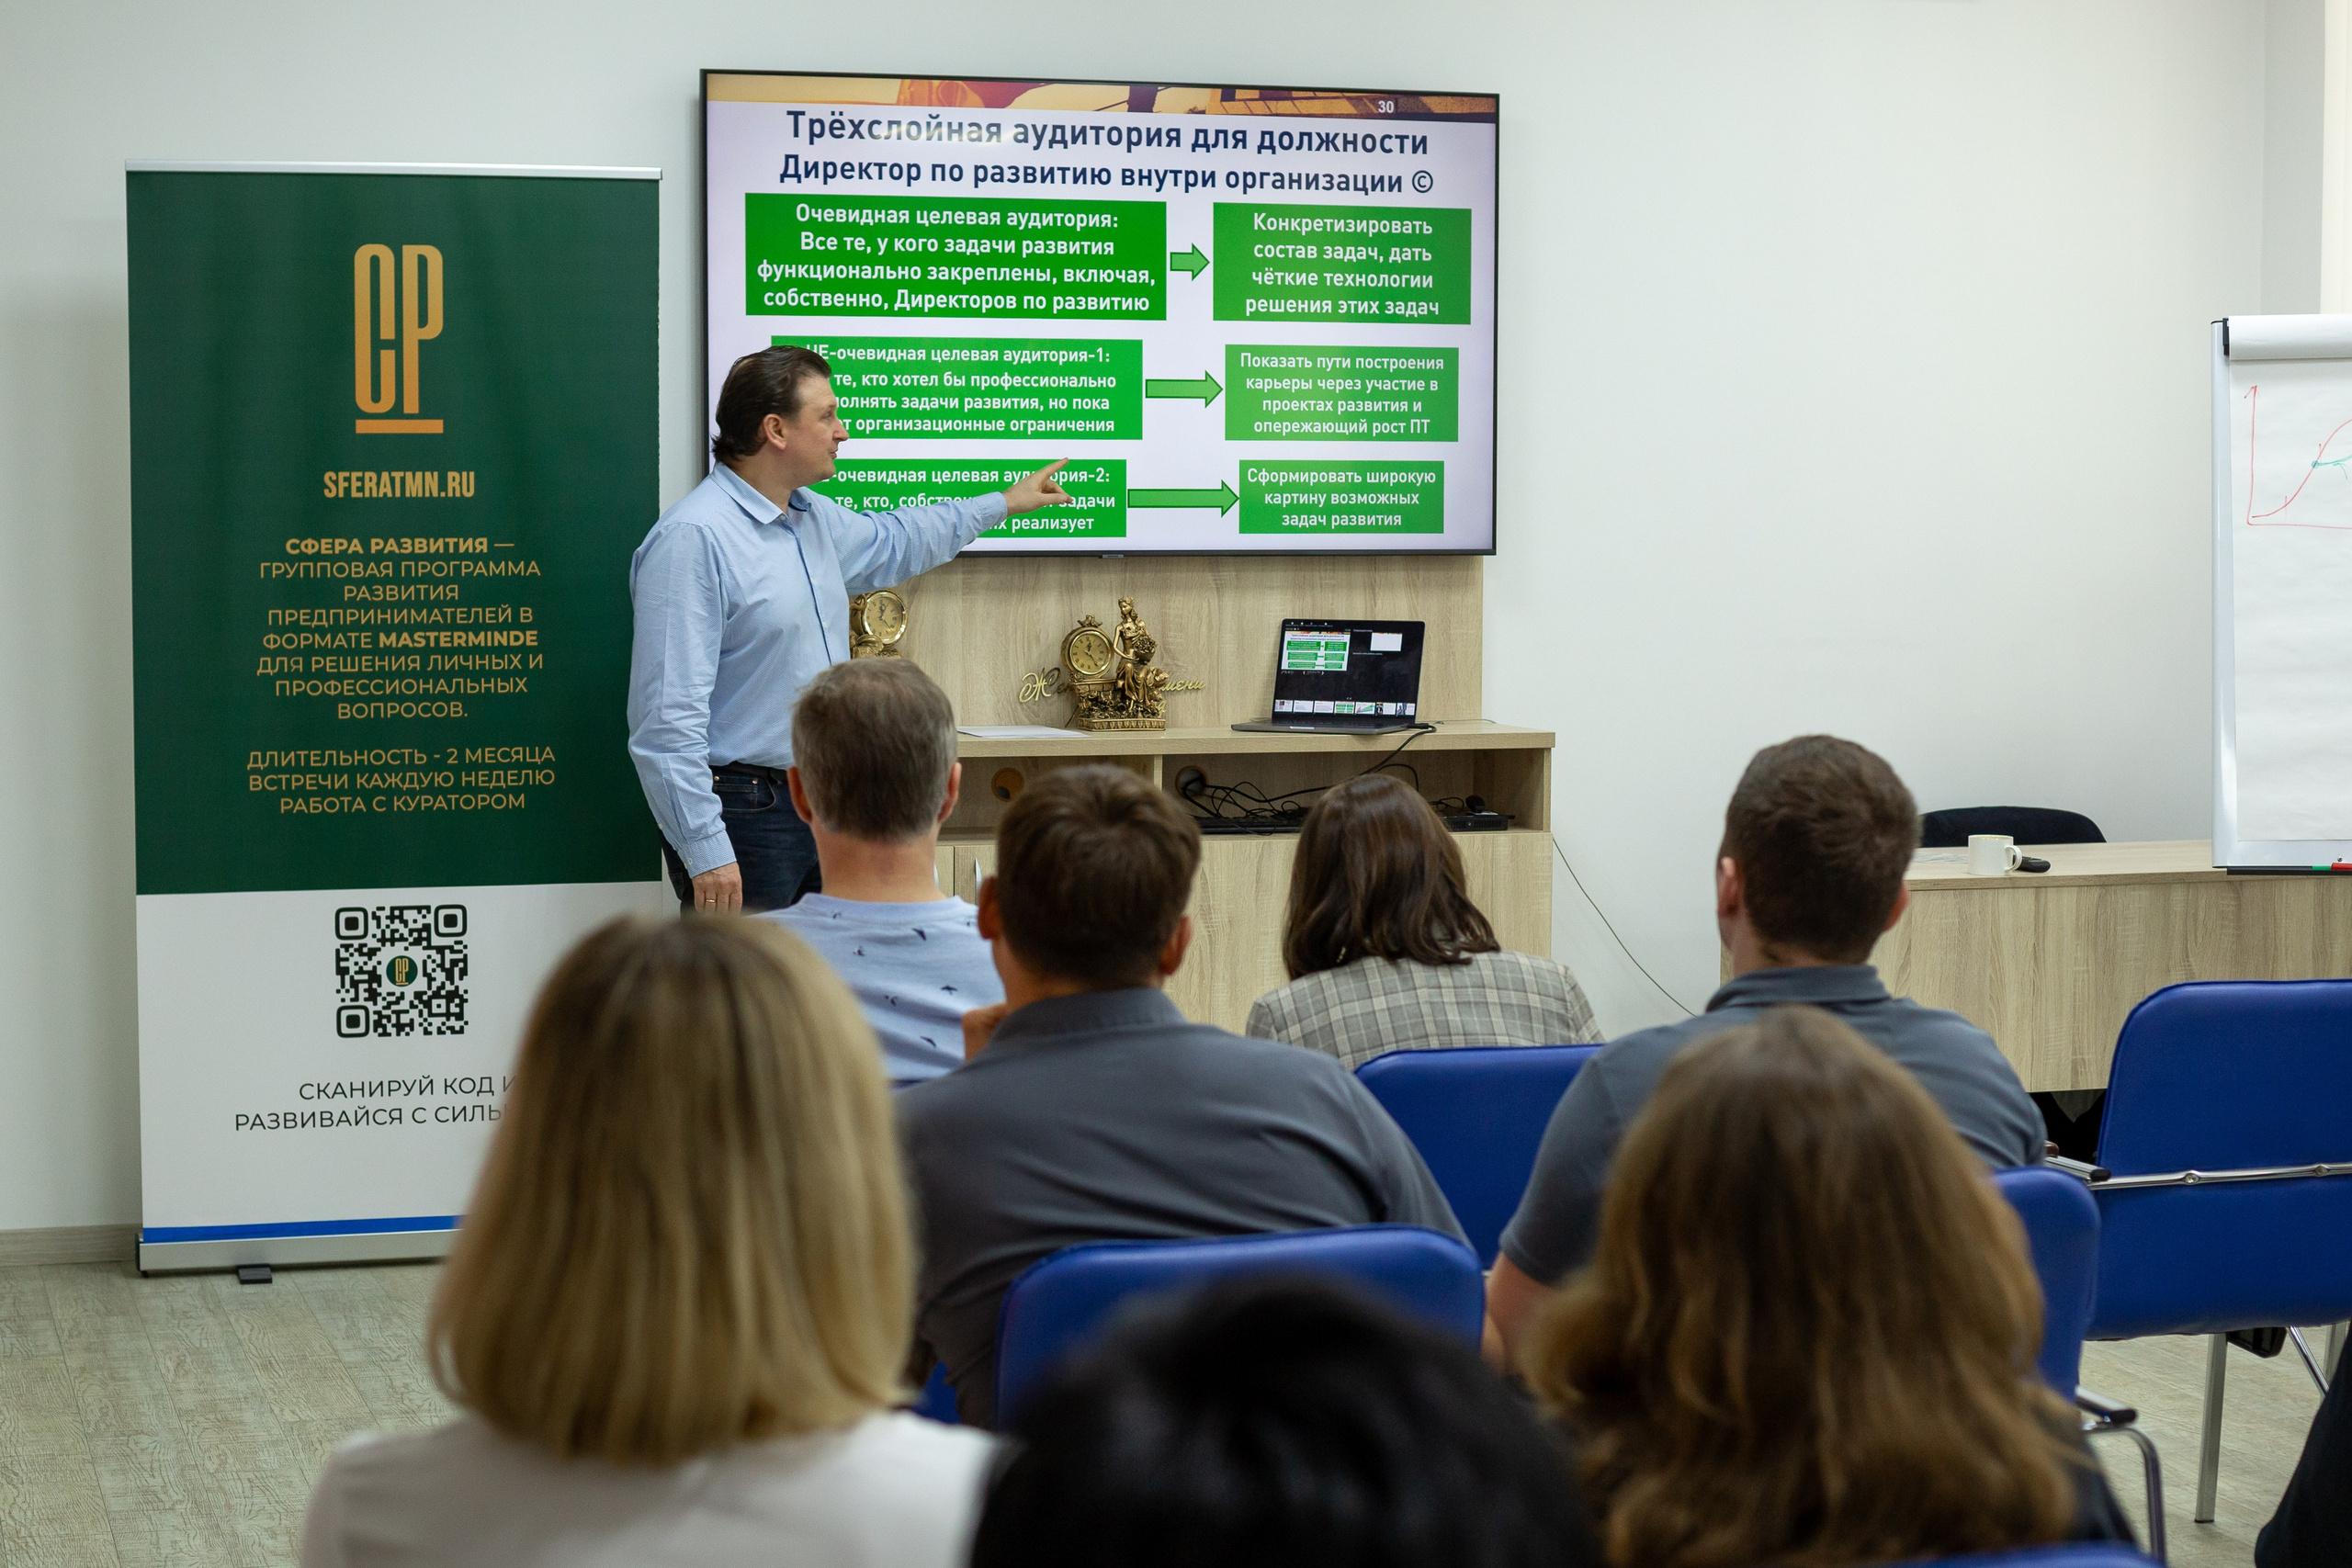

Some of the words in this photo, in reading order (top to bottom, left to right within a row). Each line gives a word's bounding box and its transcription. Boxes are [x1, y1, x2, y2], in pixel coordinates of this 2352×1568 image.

[1377, 100, 1395, 114] 30
[786, 109, 1001, 146] Трёхслойная
[1013, 123, 1182, 153] аудитория
[1191, 128, 1248, 153] для
[1257, 130, 1428, 155] должности
[779, 153, 922, 187] Директор
[931, 164, 964, 183] по
[974, 164, 1112, 189] развитию
[1123, 168, 1216, 194] внутри
[1225, 170, 1402, 197] организации
[796, 203, 910, 226] Очевидная
[916, 209, 1001, 227] целевая
[1006, 211, 1118, 231] аудитория:
[1253, 212, 1433, 238] Конкретизировать
[800, 231, 838, 251] Все
[842, 236, 872, 254] те,
[876, 237, 888, 256] у
[894, 237, 939, 253] кого
[944, 238, 1016, 256] задачи
[1022, 240, 1114, 258] развития
[1253, 243, 1317, 259] состав
[1322, 245, 1384, 264] задач,
[1388, 247, 1432, 264] дать
[757, 259, 922, 283] функционально
[927, 265, 1057, 286] закреплены,
[1063, 268, 1155, 287] включая,
[1251, 266, 1318, 286] чёткие
[1323, 272, 1433, 288] технологии
[763, 288, 888, 310] собственно,
[894, 288, 1017, 313] Директоров
[1023, 295, 1046, 310] по
[1053, 296, 1149, 314] развитию
[1246, 299, 1332, 317] решения
[1338, 299, 1380, 314] этих
[1385, 300, 1439, 318] задач
[354, 243, 444, 414] СР
[931, 349, 999, 363] целевая
[1002, 346, 1110, 366] аудитория-1:
[1240, 352, 1313, 368] Показать
[1317, 357, 1351, 372] пути
[1355, 357, 1444, 373] построения
[833, 374, 857, 389] те,
[862, 374, 888, 386] кто
[892, 374, 939, 387] хотел
[943, 371, 966, 387] бы
[970, 371, 1116, 391] профессионально
[1246, 378, 1313, 393] карьеры
[1317, 378, 1362, 394] через
[1365, 378, 1426, 394] участие
[1430, 379, 1439, 391] в
[836, 396, 898, 409] олнять
[900, 397, 959, 412] задачи
[964, 397, 1044, 413] развития,
[1048, 398, 1069, 410] но
[1072, 398, 1110, 410] пока
[1262, 400, 1334, 415] проектах
[1337, 400, 1408, 415] развития
[1413, 400, 1422, 412] и
[855, 419, 1006, 434] организационные
[1010, 419, 1114, 435] ограничения
[1253, 418, 1368, 436] опережающий
[1372, 422, 1407, 437] рост
[1410, 419, 1430, 434] ПТ
[323, 470, 475, 498] SFERATMN.RU
[821, 470, 927, 485] -очевидная
[932, 470, 999, 485] целевая
[1247, 468, 1363, 487] Сформировать
[1366, 471, 1436, 487] широкую
[863, 496, 894, 511] кто,
[1264, 492, 1327, 508] картину
[1330, 493, 1419, 504] возможных
[1012, 518, 1095, 534] реализует
[1282, 514, 1327, 528] задач
[1331, 514, 1402, 530] развития
[285, 537, 364, 555] СФЕРА
[370, 537, 488, 554] РАЗВИТИЯ
[260, 561, 393, 579] ГРУППОВАЯ
[401, 560, 541, 578] ПРОГРАММА
[344, 584, 458, 602] РАЗВИТИЯ
[268, 604, 512, 628] ПРЕДПРИНИМАТЕЛЕЙ
[519, 606, 533, 623] В
[263, 632, 373, 650] ФОРМАТЕ
[379, 630, 538, 649] MASTERMINDE
[256, 656, 303, 677] ДЛЯ
[311, 655, 421, 672] РЕШЕНИЯ
[426, 653, 522, 671] ЛИЧНЫХ
[529, 653, 543, 670] И
[276, 677, 527, 696] ПРОФЕССИОНАЛЬНЫХ
[337, 701, 469, 719] ВОПРОСОВ.
[246, 749, 427, 771] ДЛИТЕЛЬНОСТЬ
[447, 748, 458, 764] 2
[465, 746, 556, 765] МЕСЯЦА
[249, 773, 348, 791] ВСТРЕЧИ
[356, 771, 455, 791] КАЖДУЮ
[461, 769, 555, 790] НЕДЕЛЮ
[280, 796, 367, 814] РАБОТА
[372, 795, 387, 812] С
[393, 793, 525, 812] КУРАТОРОМ
[395, 958, 409, 983] СР
[299, 1075, 434, 1100] СКАНИРУЙ
[444, 1076, 495, 1098] КОД
[235, 1105, 402, 1132] РАЗВИВАЙСЯ
[412, 1107, 427, 1124] С
[434, 1104, 508, 1123] СИЛЬ
